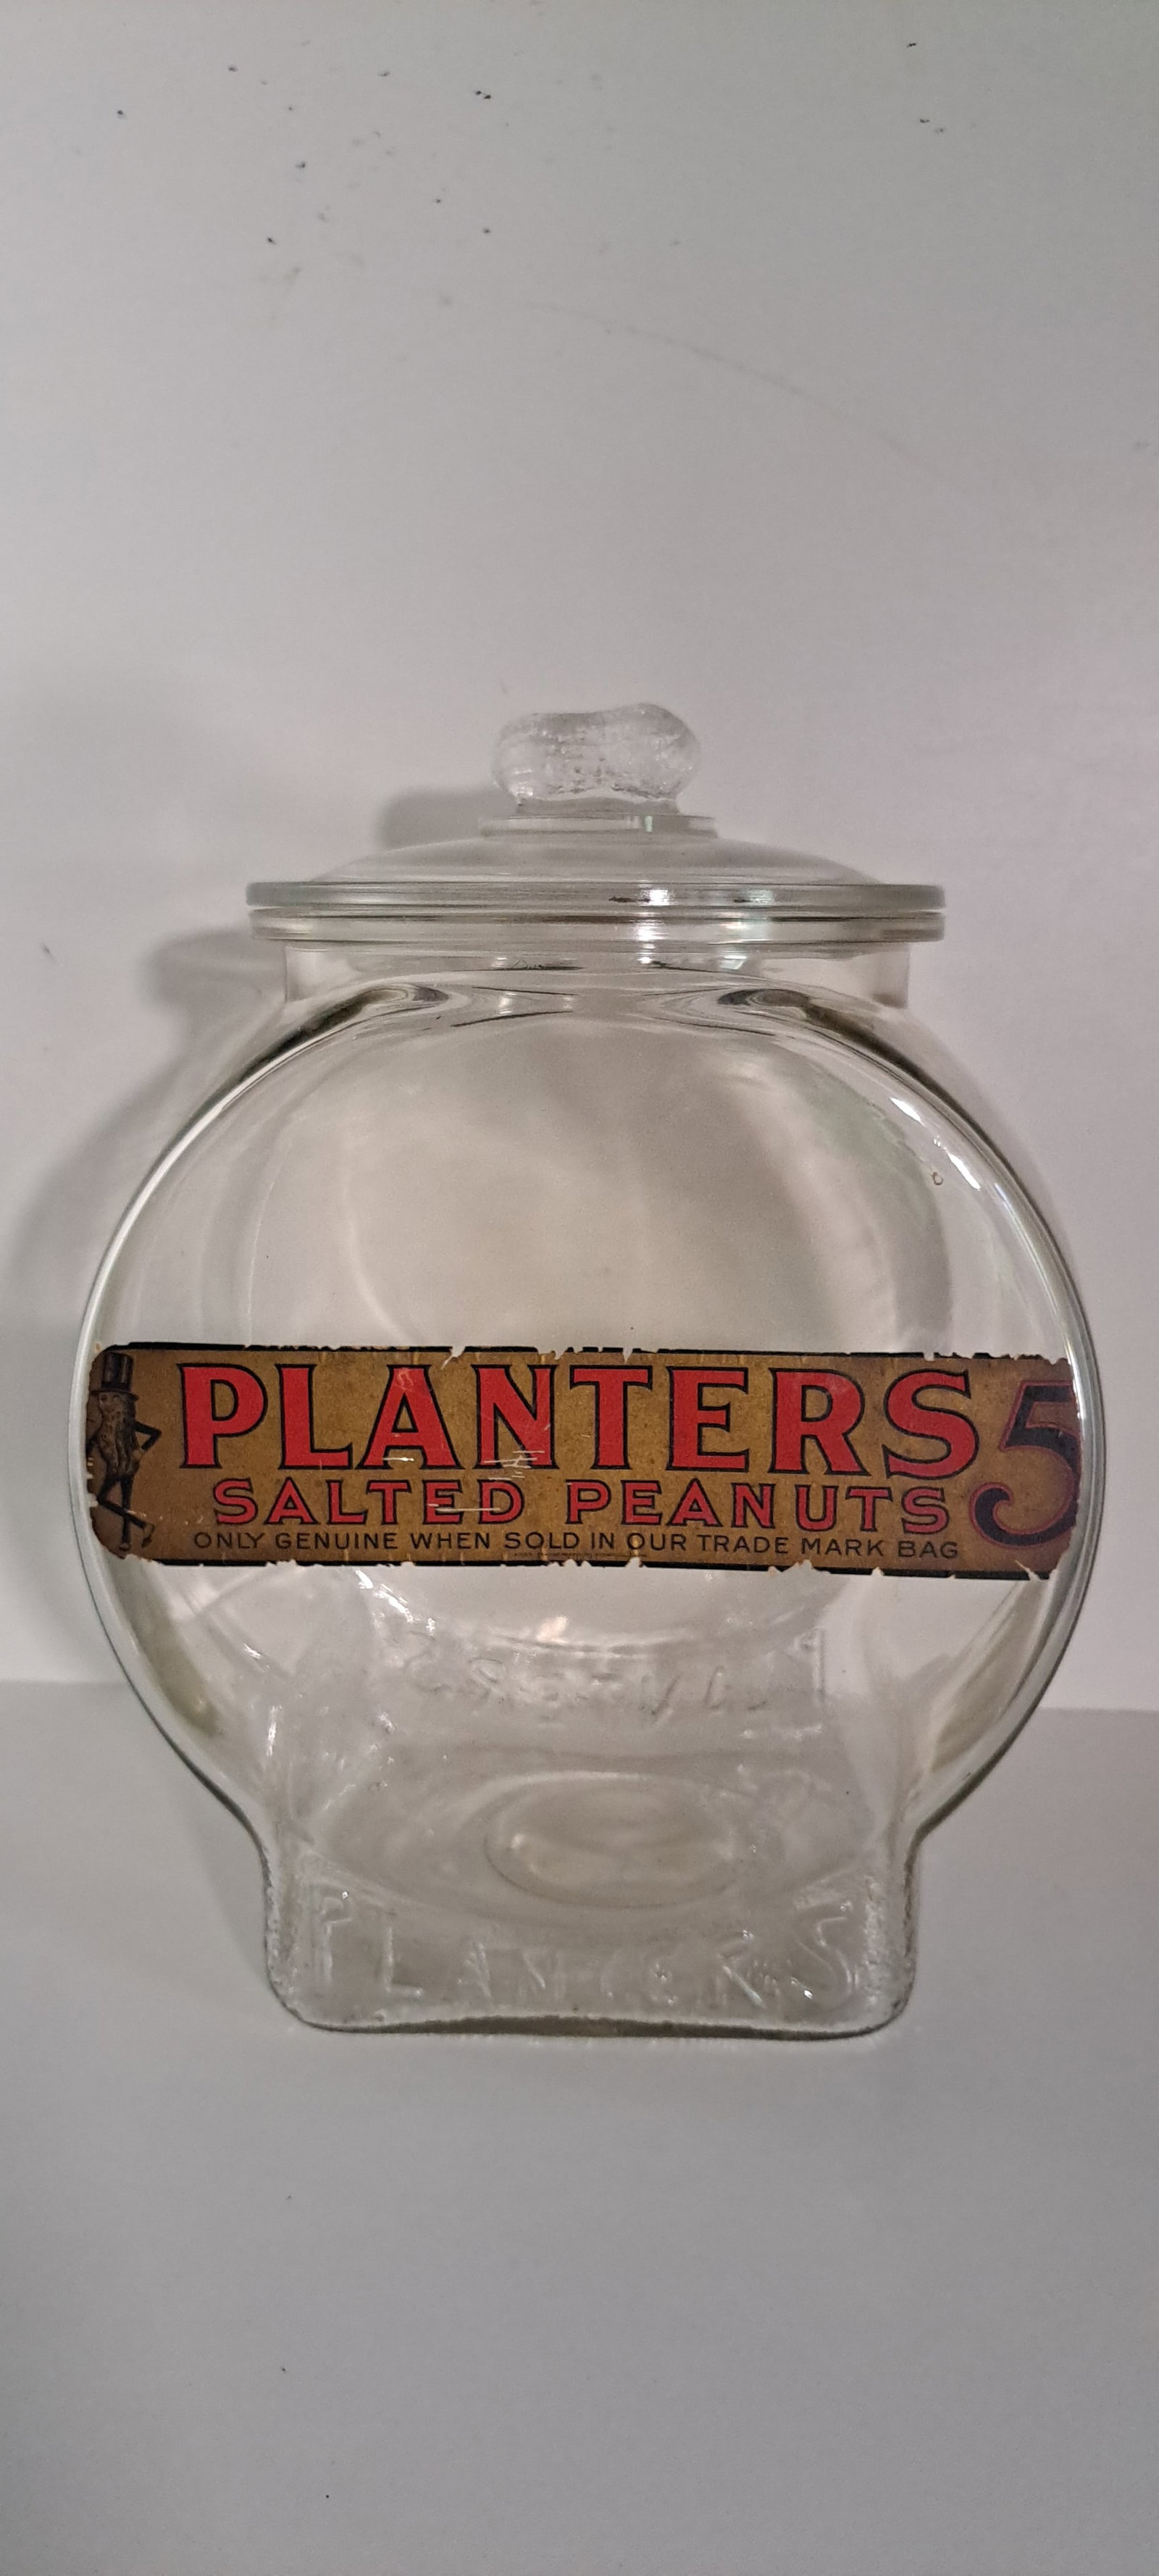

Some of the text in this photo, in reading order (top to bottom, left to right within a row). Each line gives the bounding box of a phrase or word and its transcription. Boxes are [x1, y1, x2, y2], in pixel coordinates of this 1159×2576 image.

[178, 1363, 980, 1479] PLANTERS
[970, 1380, 1081, 1547] 5
[194, 1531, 958, 1560] ONLY GENUINE WHEN SOLD IN OUR TRADE MARK BAG
[214, 1477, 949, 1534] SALTED PEANUTS
